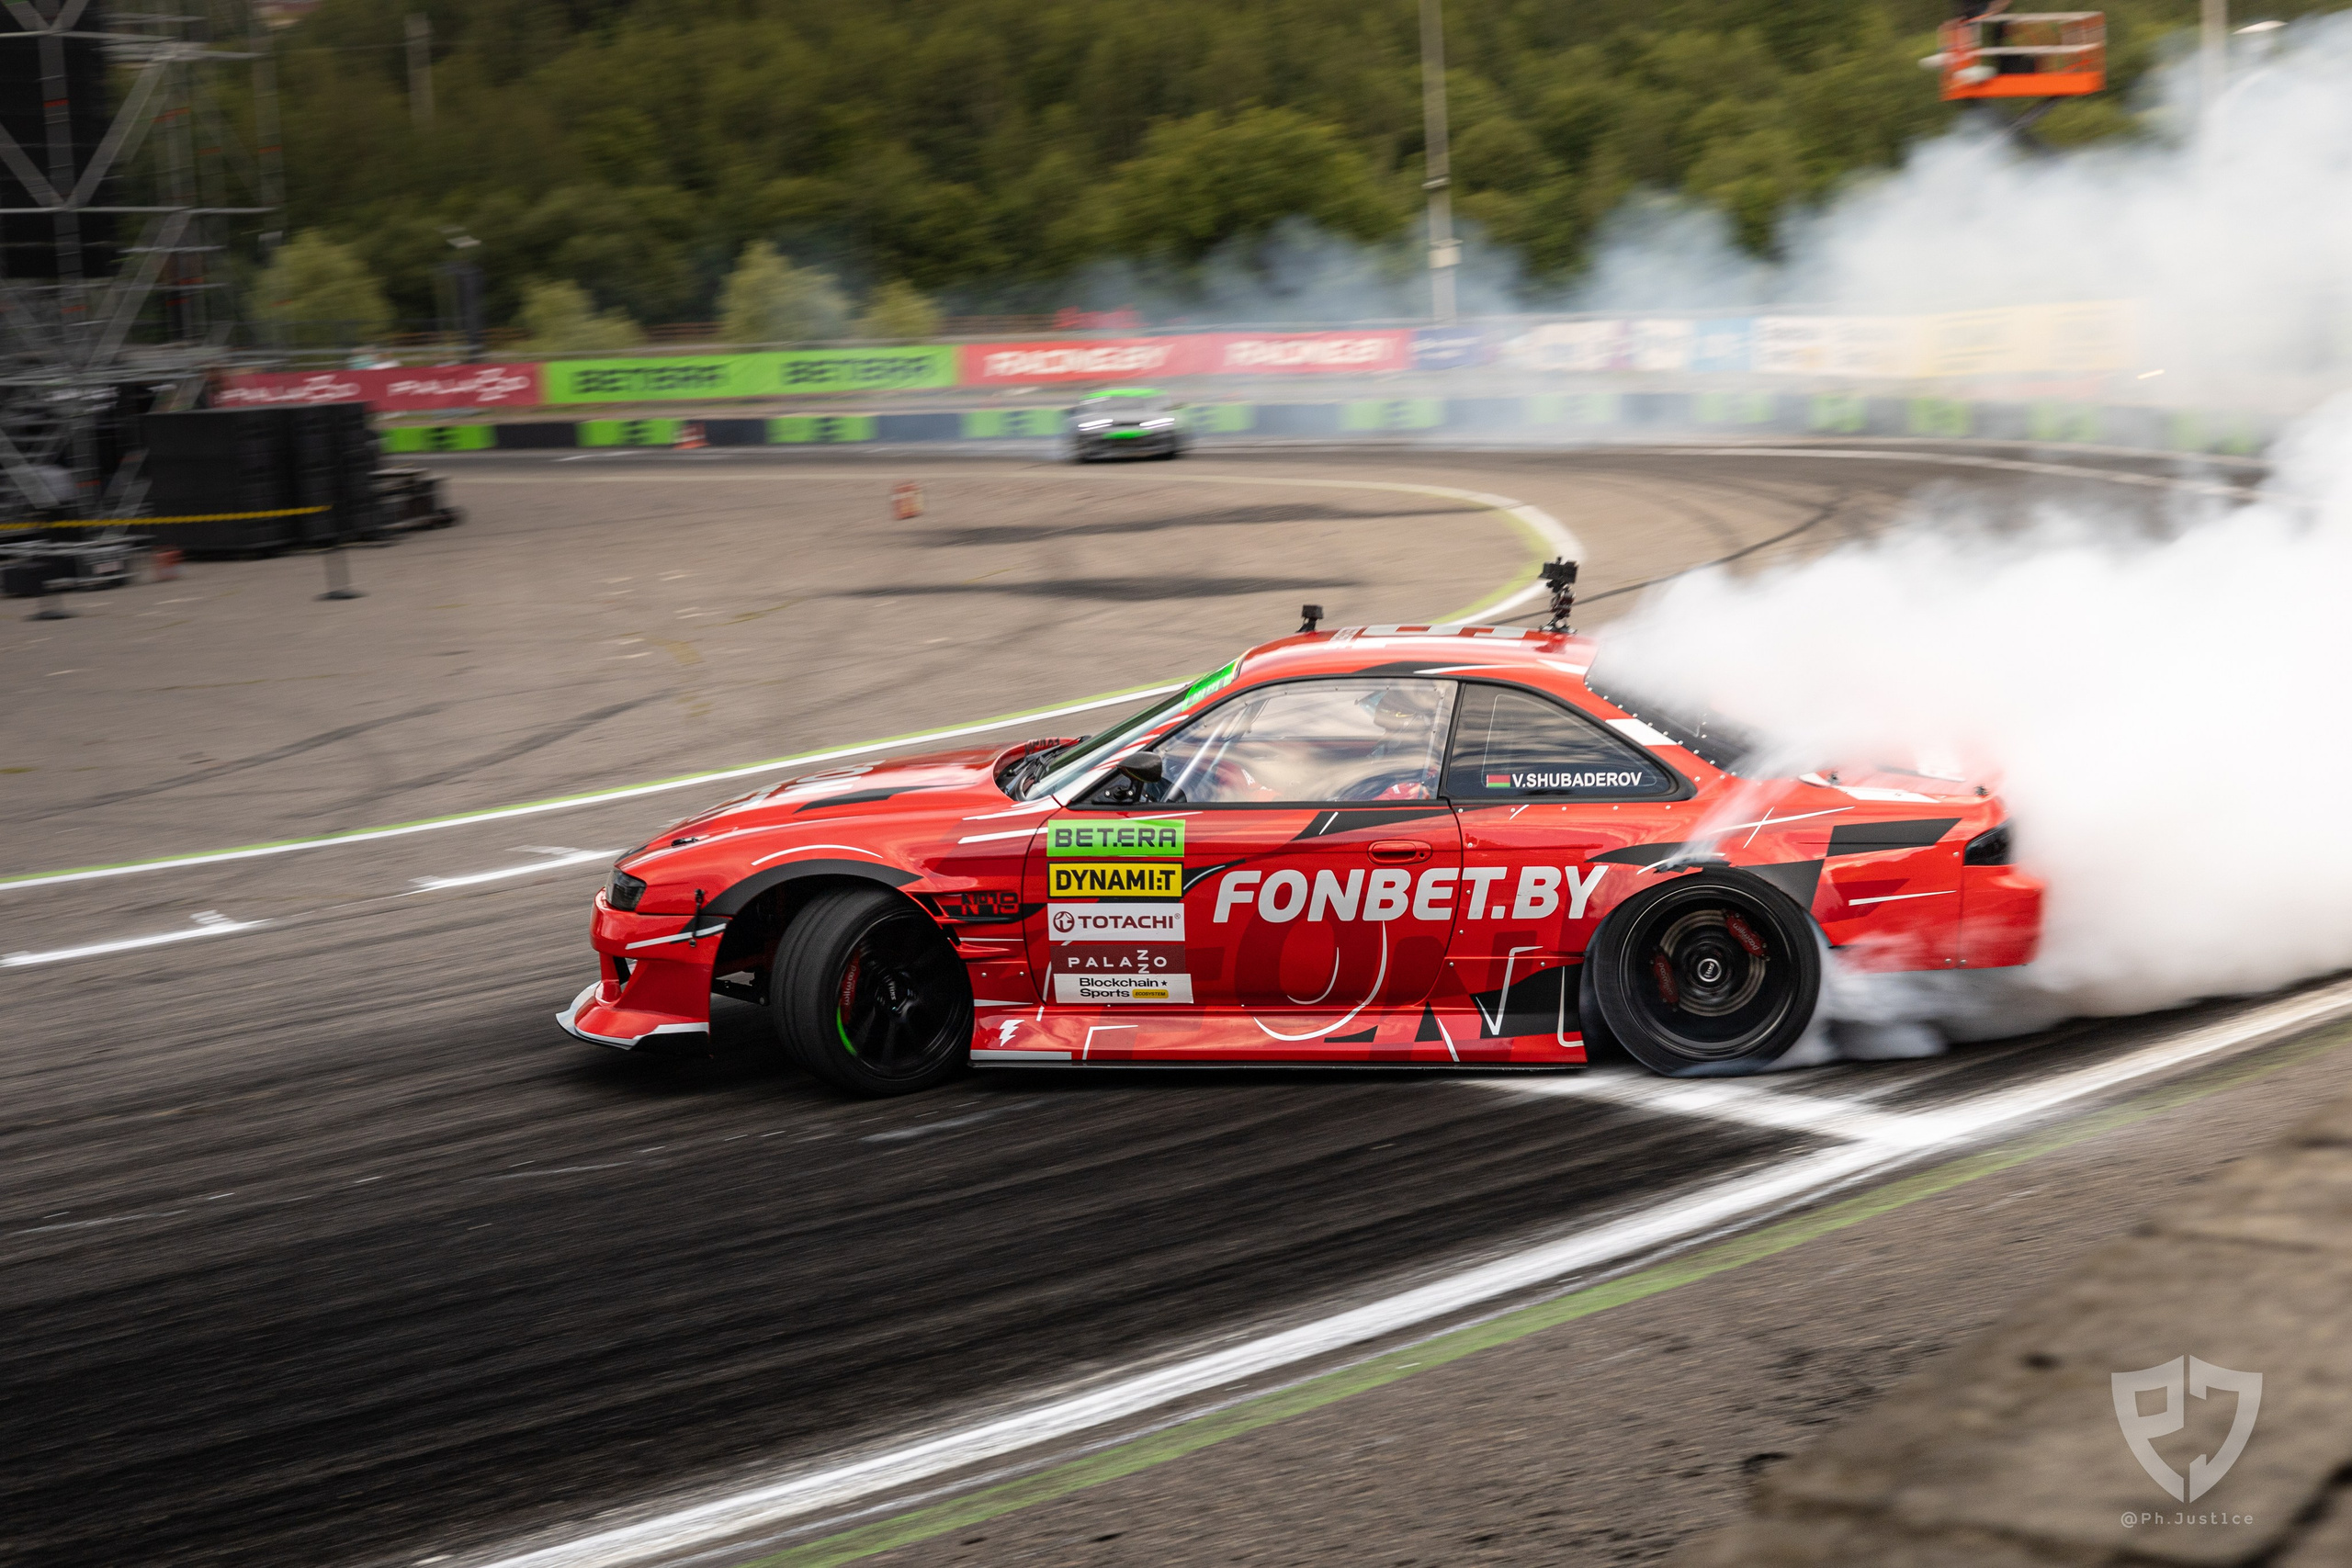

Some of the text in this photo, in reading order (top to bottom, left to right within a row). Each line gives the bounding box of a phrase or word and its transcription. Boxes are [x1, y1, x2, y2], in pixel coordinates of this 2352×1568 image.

[1512, 772, 1643, 787] V.SHUBADEROV
[1055, 828, 1177, 848] BET.ERA
[1213, 865, 1610, 923] FONBET.BY
[1079, 977, 1159, 987] Blockchain
[1080, 988, 1130, 998] Sports
